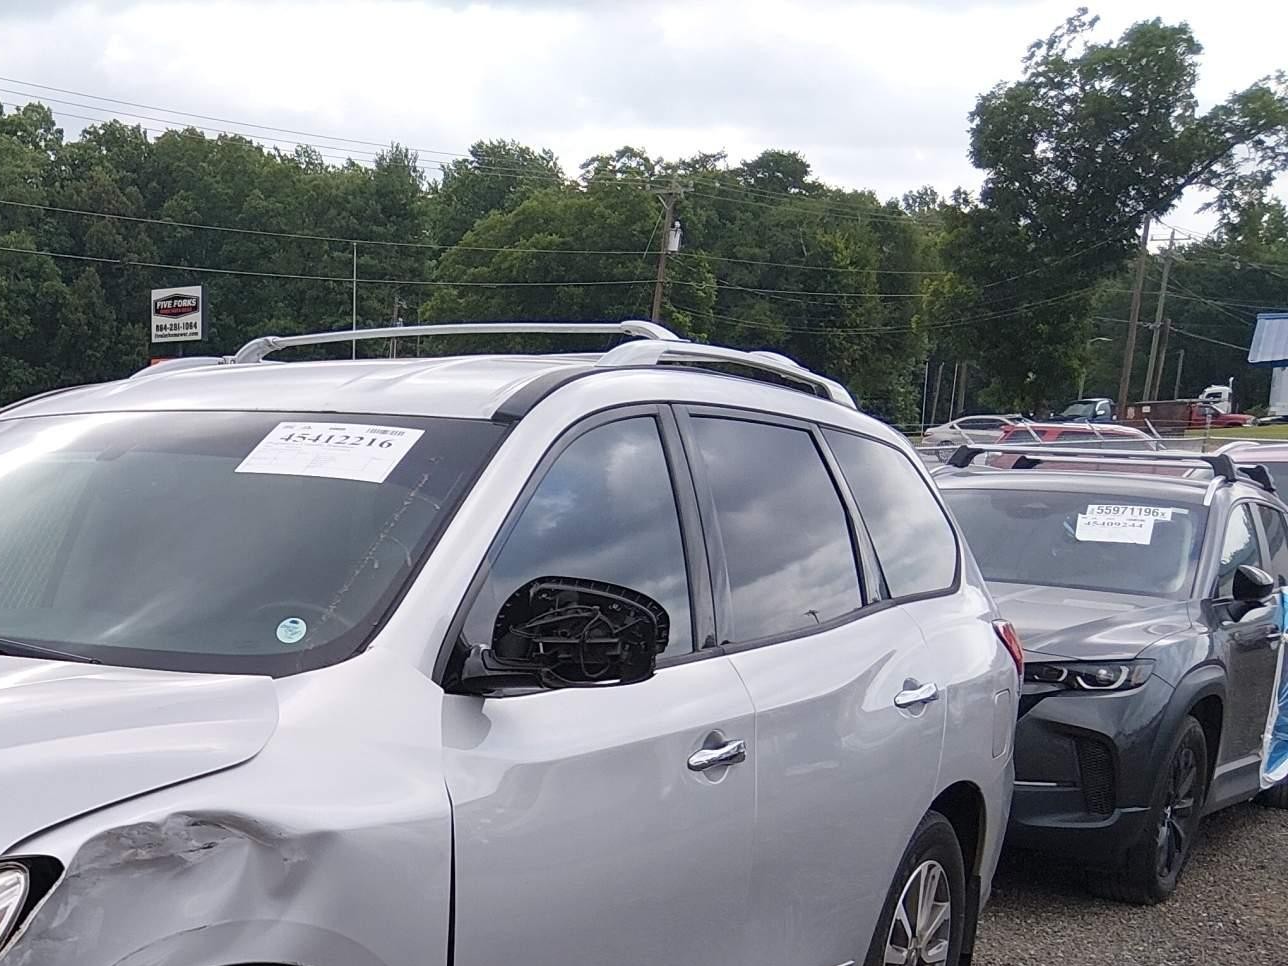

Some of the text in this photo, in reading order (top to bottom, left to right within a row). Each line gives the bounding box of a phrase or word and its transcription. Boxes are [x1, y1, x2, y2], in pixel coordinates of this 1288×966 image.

[156, 299, 197, 309] FIVE FORKS
[280, 433, 393, 448] 45412216
[1096, 506, 1160, 517] 55971196
